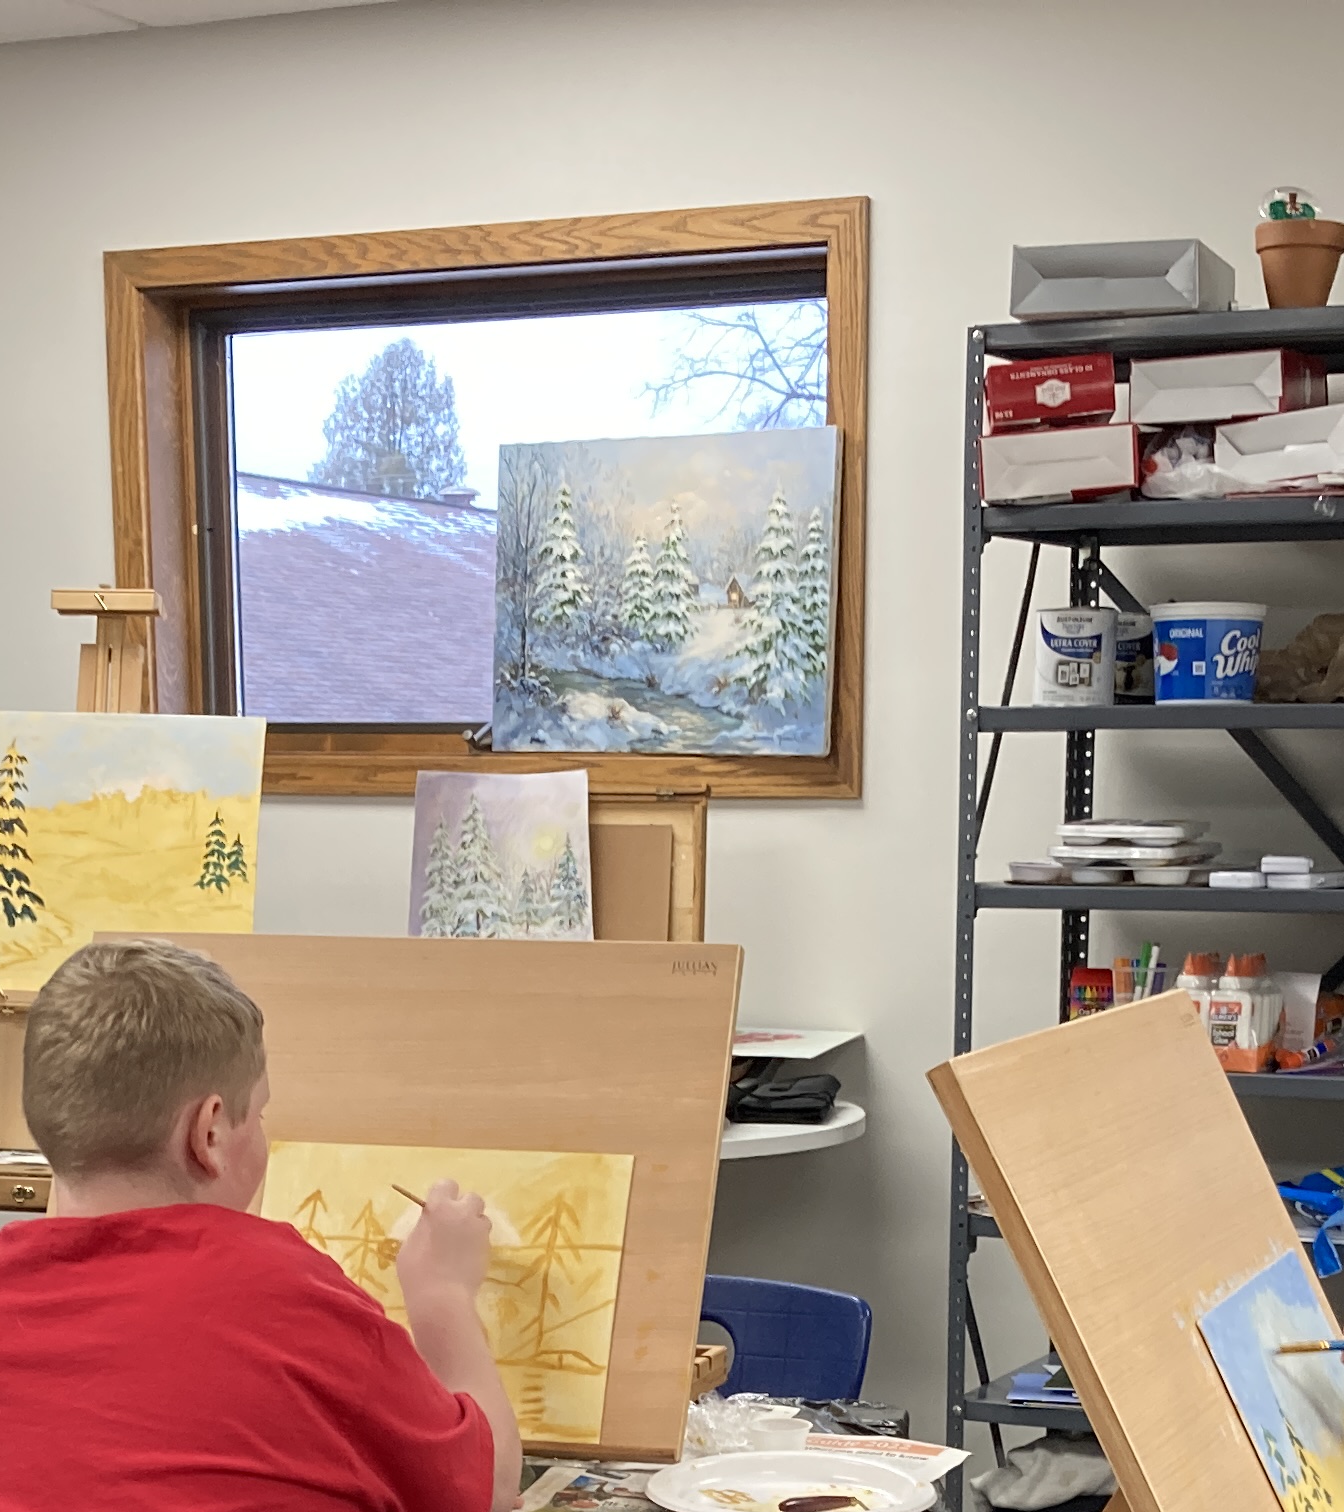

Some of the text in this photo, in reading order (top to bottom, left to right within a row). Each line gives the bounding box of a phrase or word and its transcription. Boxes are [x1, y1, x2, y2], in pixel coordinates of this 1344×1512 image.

[1169, 628, 1204, 639] ORIGINAL
[1073, 637, 1098, 648] COVER
[1220, 628, 1260, 657] Cool
[864, 1440, 911, 1451] 2022
